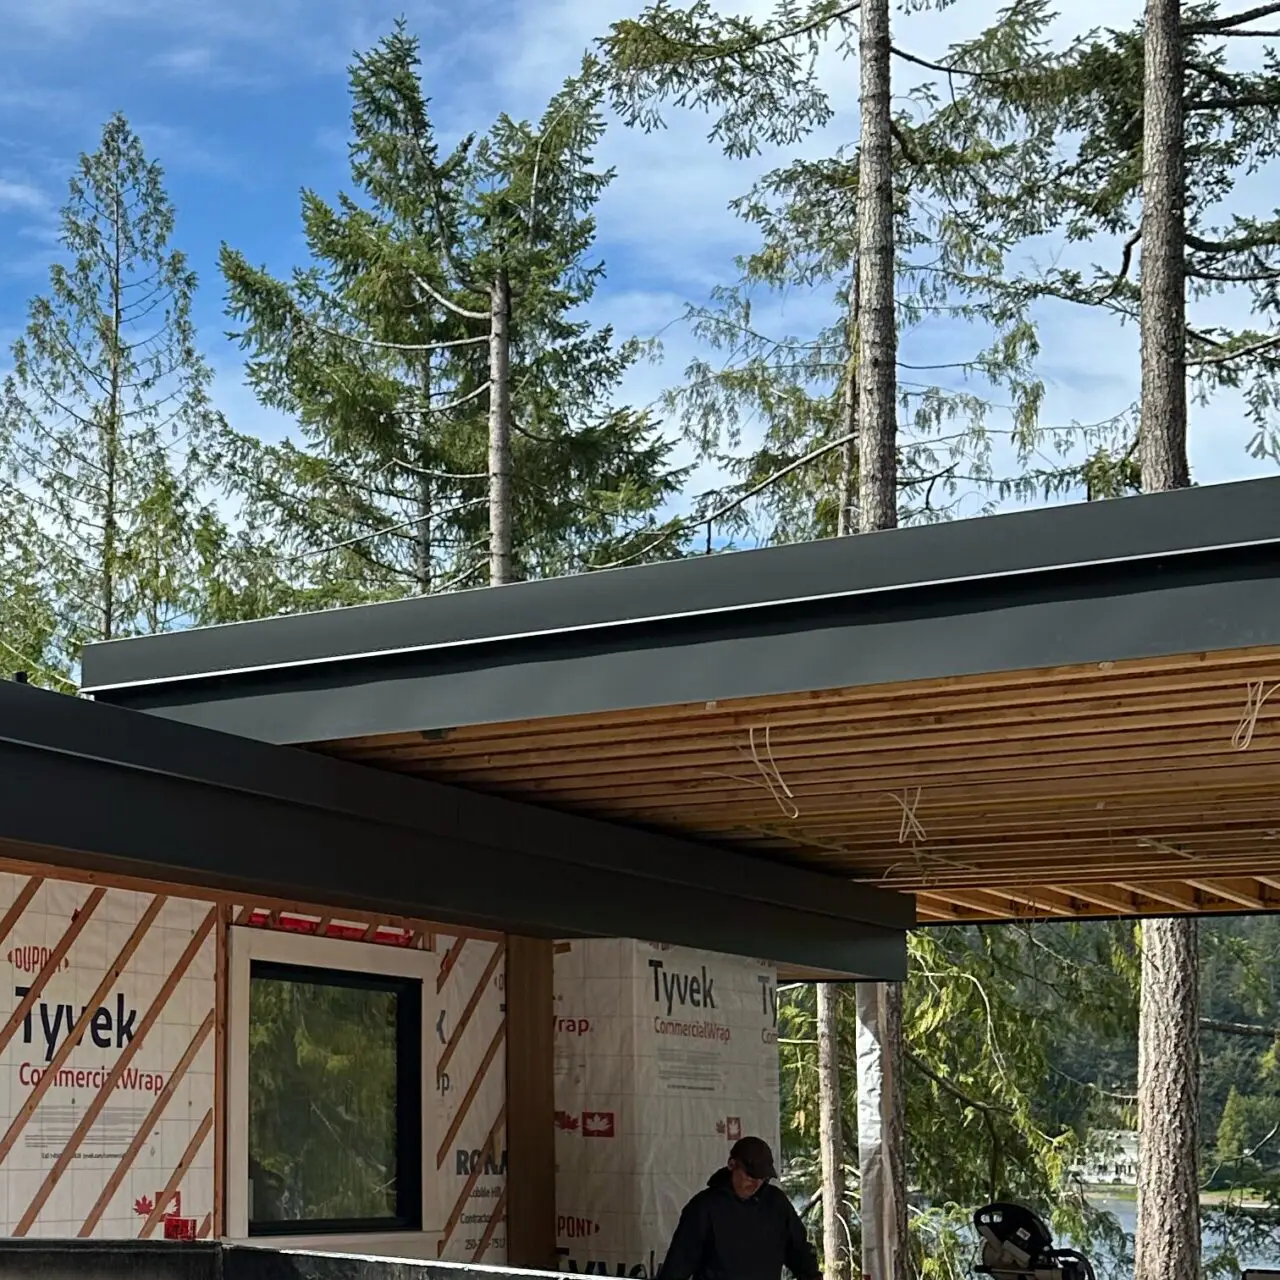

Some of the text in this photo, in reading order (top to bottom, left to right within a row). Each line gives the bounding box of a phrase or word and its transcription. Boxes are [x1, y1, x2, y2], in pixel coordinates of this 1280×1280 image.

[14, 946, 61, 974] DUPO
[648, 959, 716, 1017] Tyvek
[15, 983, 137, 1063] Tyvek
[654, 1016, 731, 1045] CommercialWrap
[19, 1062, 164, 1095] ComerciWrap
